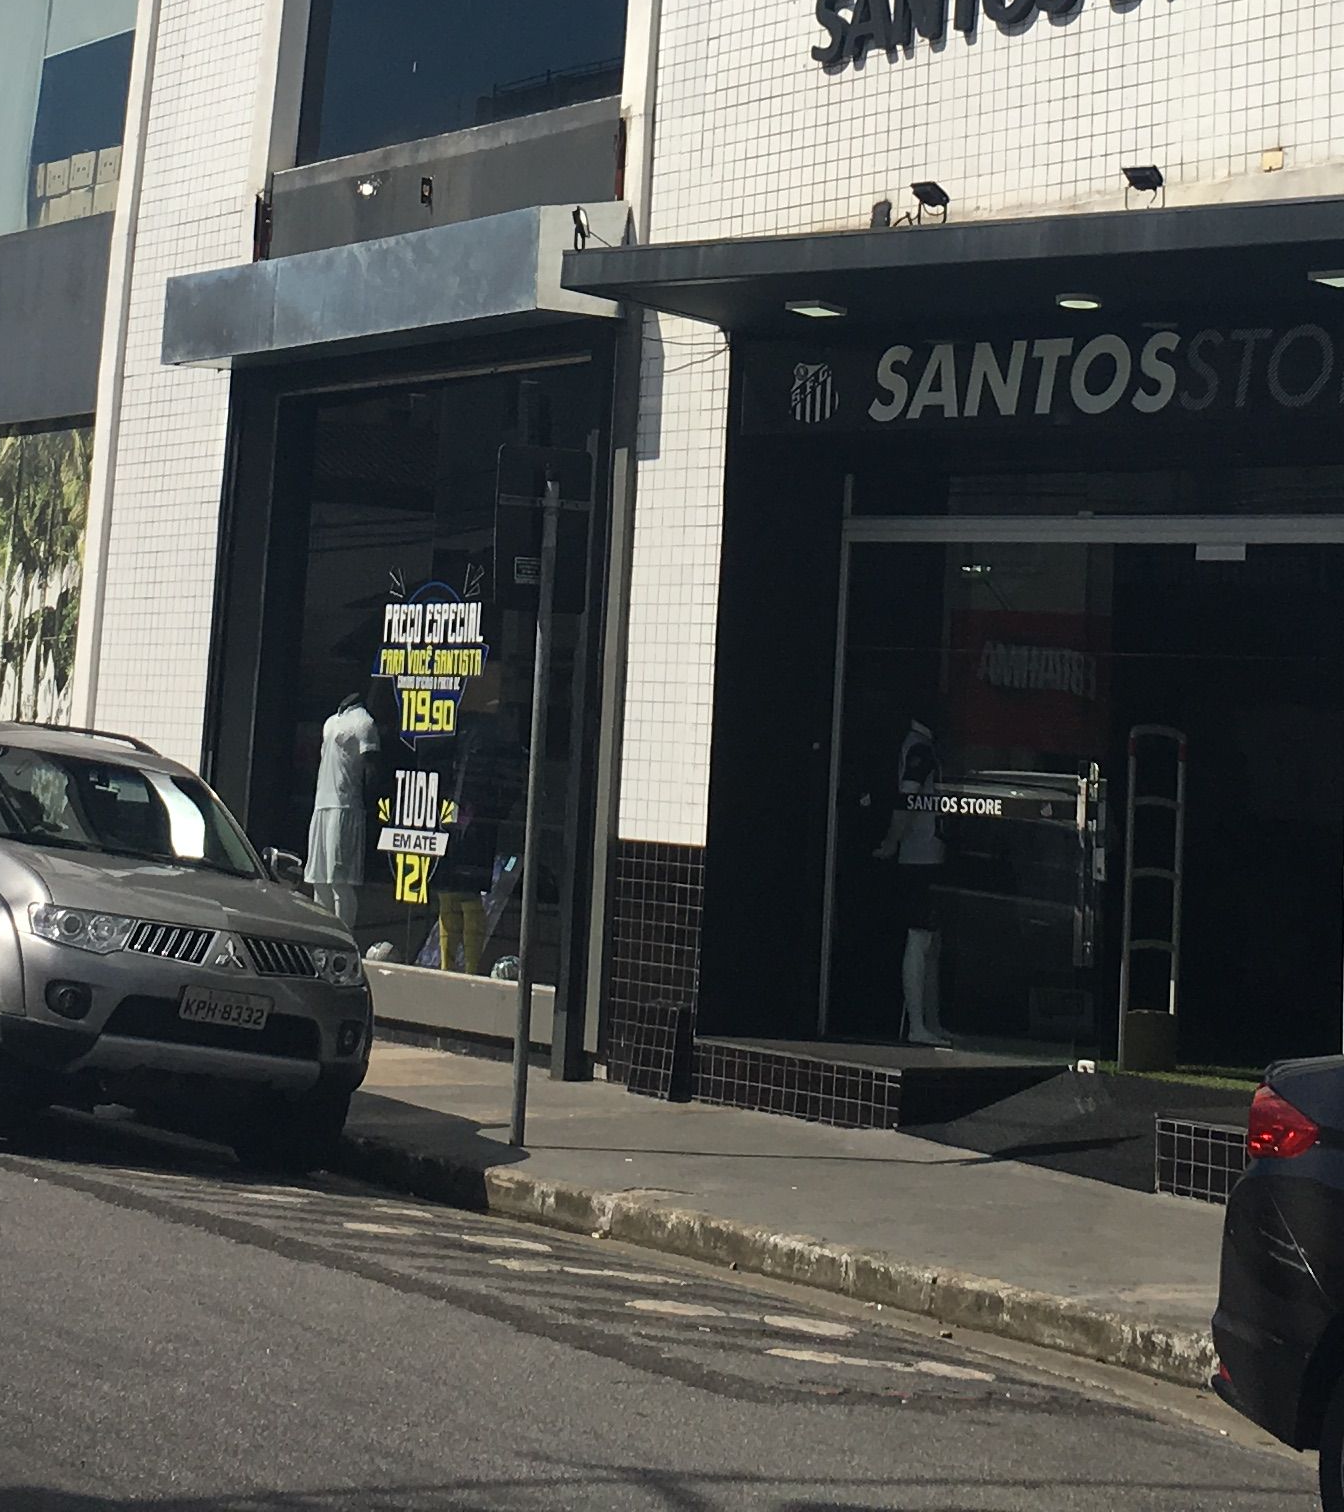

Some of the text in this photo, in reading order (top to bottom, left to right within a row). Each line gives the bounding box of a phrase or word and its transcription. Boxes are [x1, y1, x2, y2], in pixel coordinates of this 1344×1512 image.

[384, 602, 484, 648] PREÇO ESPECIAL
[380, 645, 482, 676] PARA VOCÊ SANTISTA
[402, 691, 455, 732] 119,90
[395, 769, 439, 828] TUDO
[907, 794, 1002, 815] SANTOS STORE
[392, 830, 438, 852] EM ATÉ
[396, 853, 431, 904] 12X
